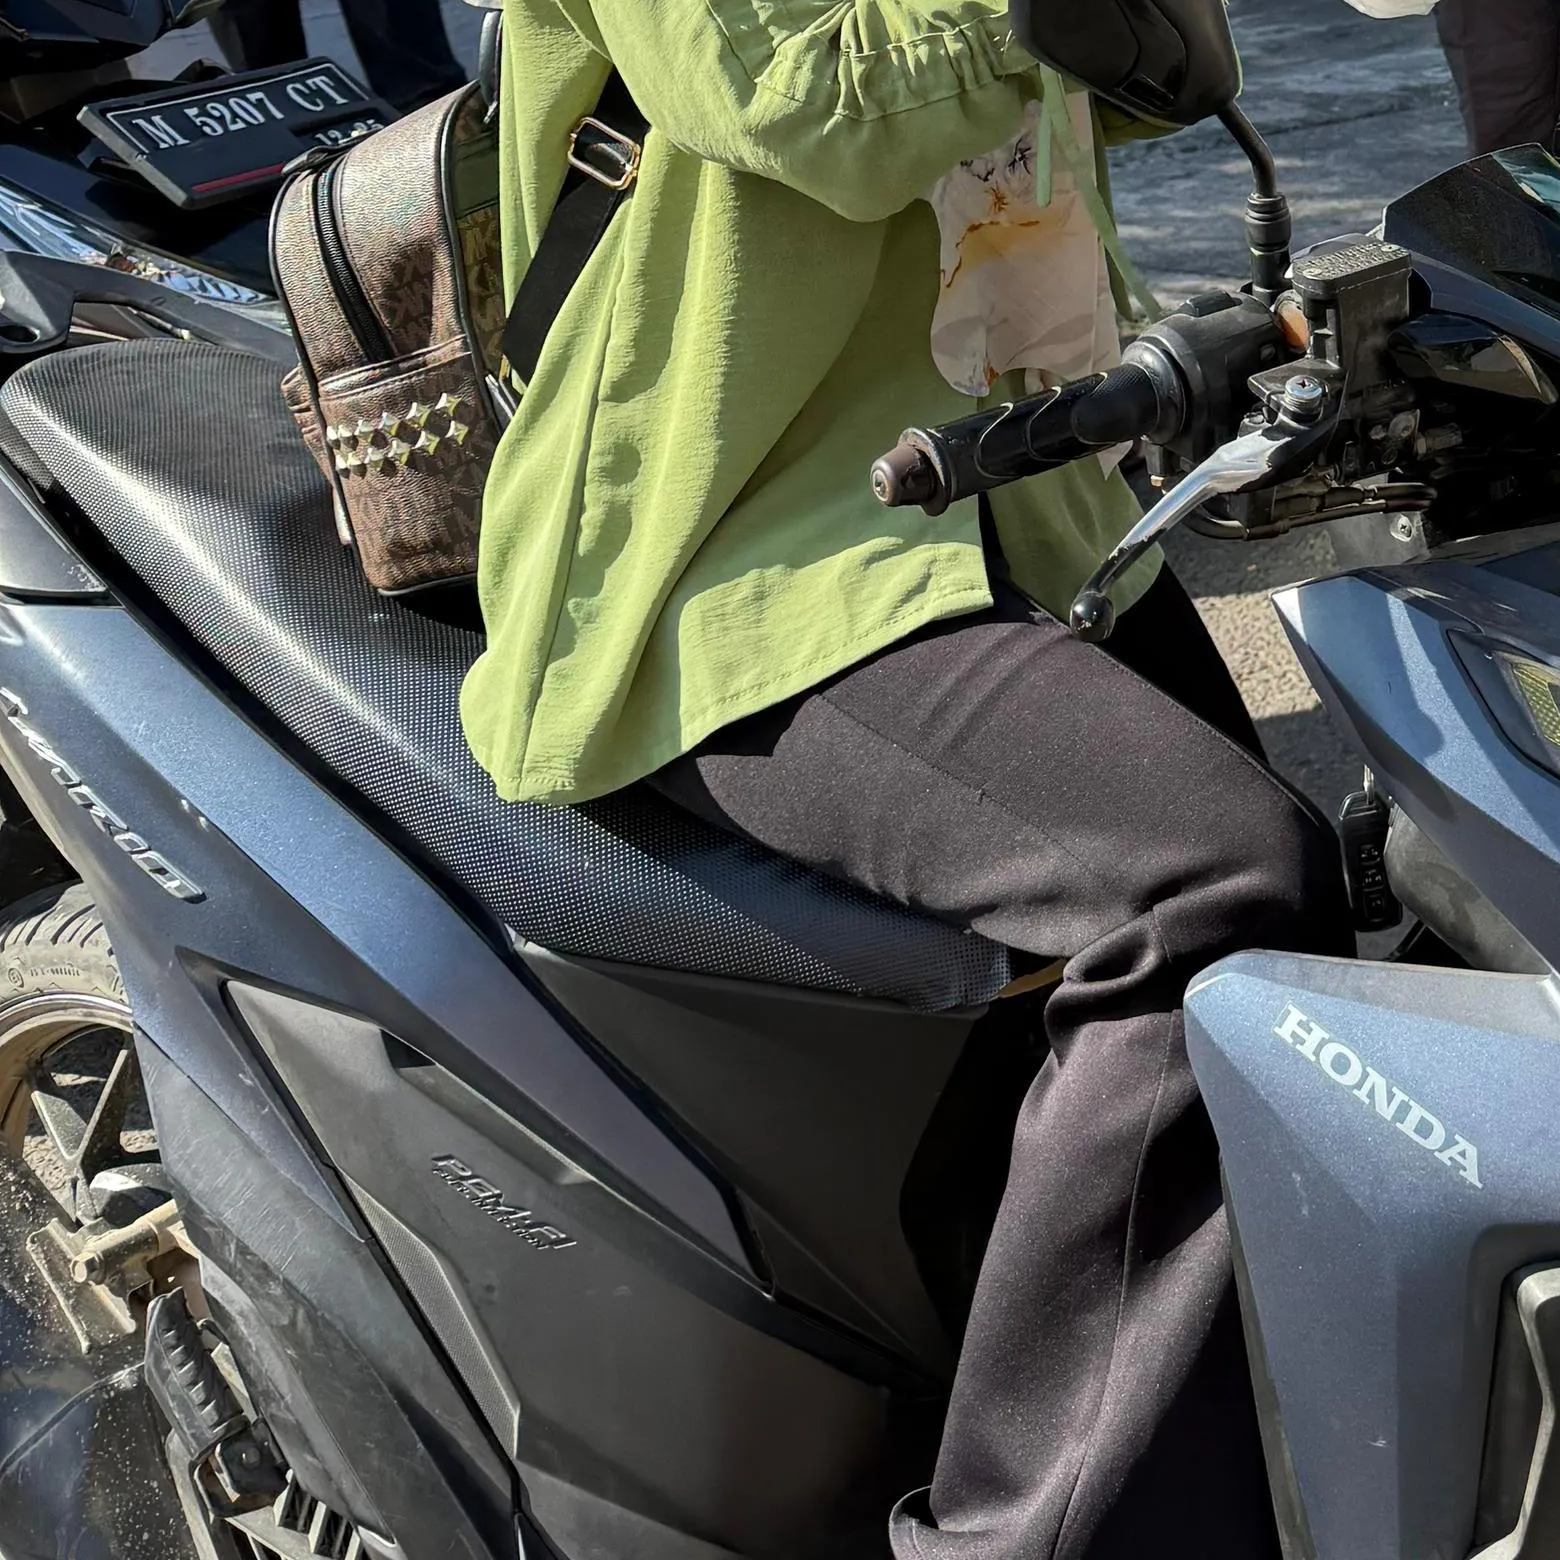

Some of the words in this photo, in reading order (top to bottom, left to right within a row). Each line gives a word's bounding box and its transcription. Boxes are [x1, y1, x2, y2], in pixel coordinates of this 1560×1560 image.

[131, 114, 191, 149] M
[183, 90, 284, 137] 5207
[285, 74, 349, 112] CT
[1273, 1002, 1484, 1190] HONDA
